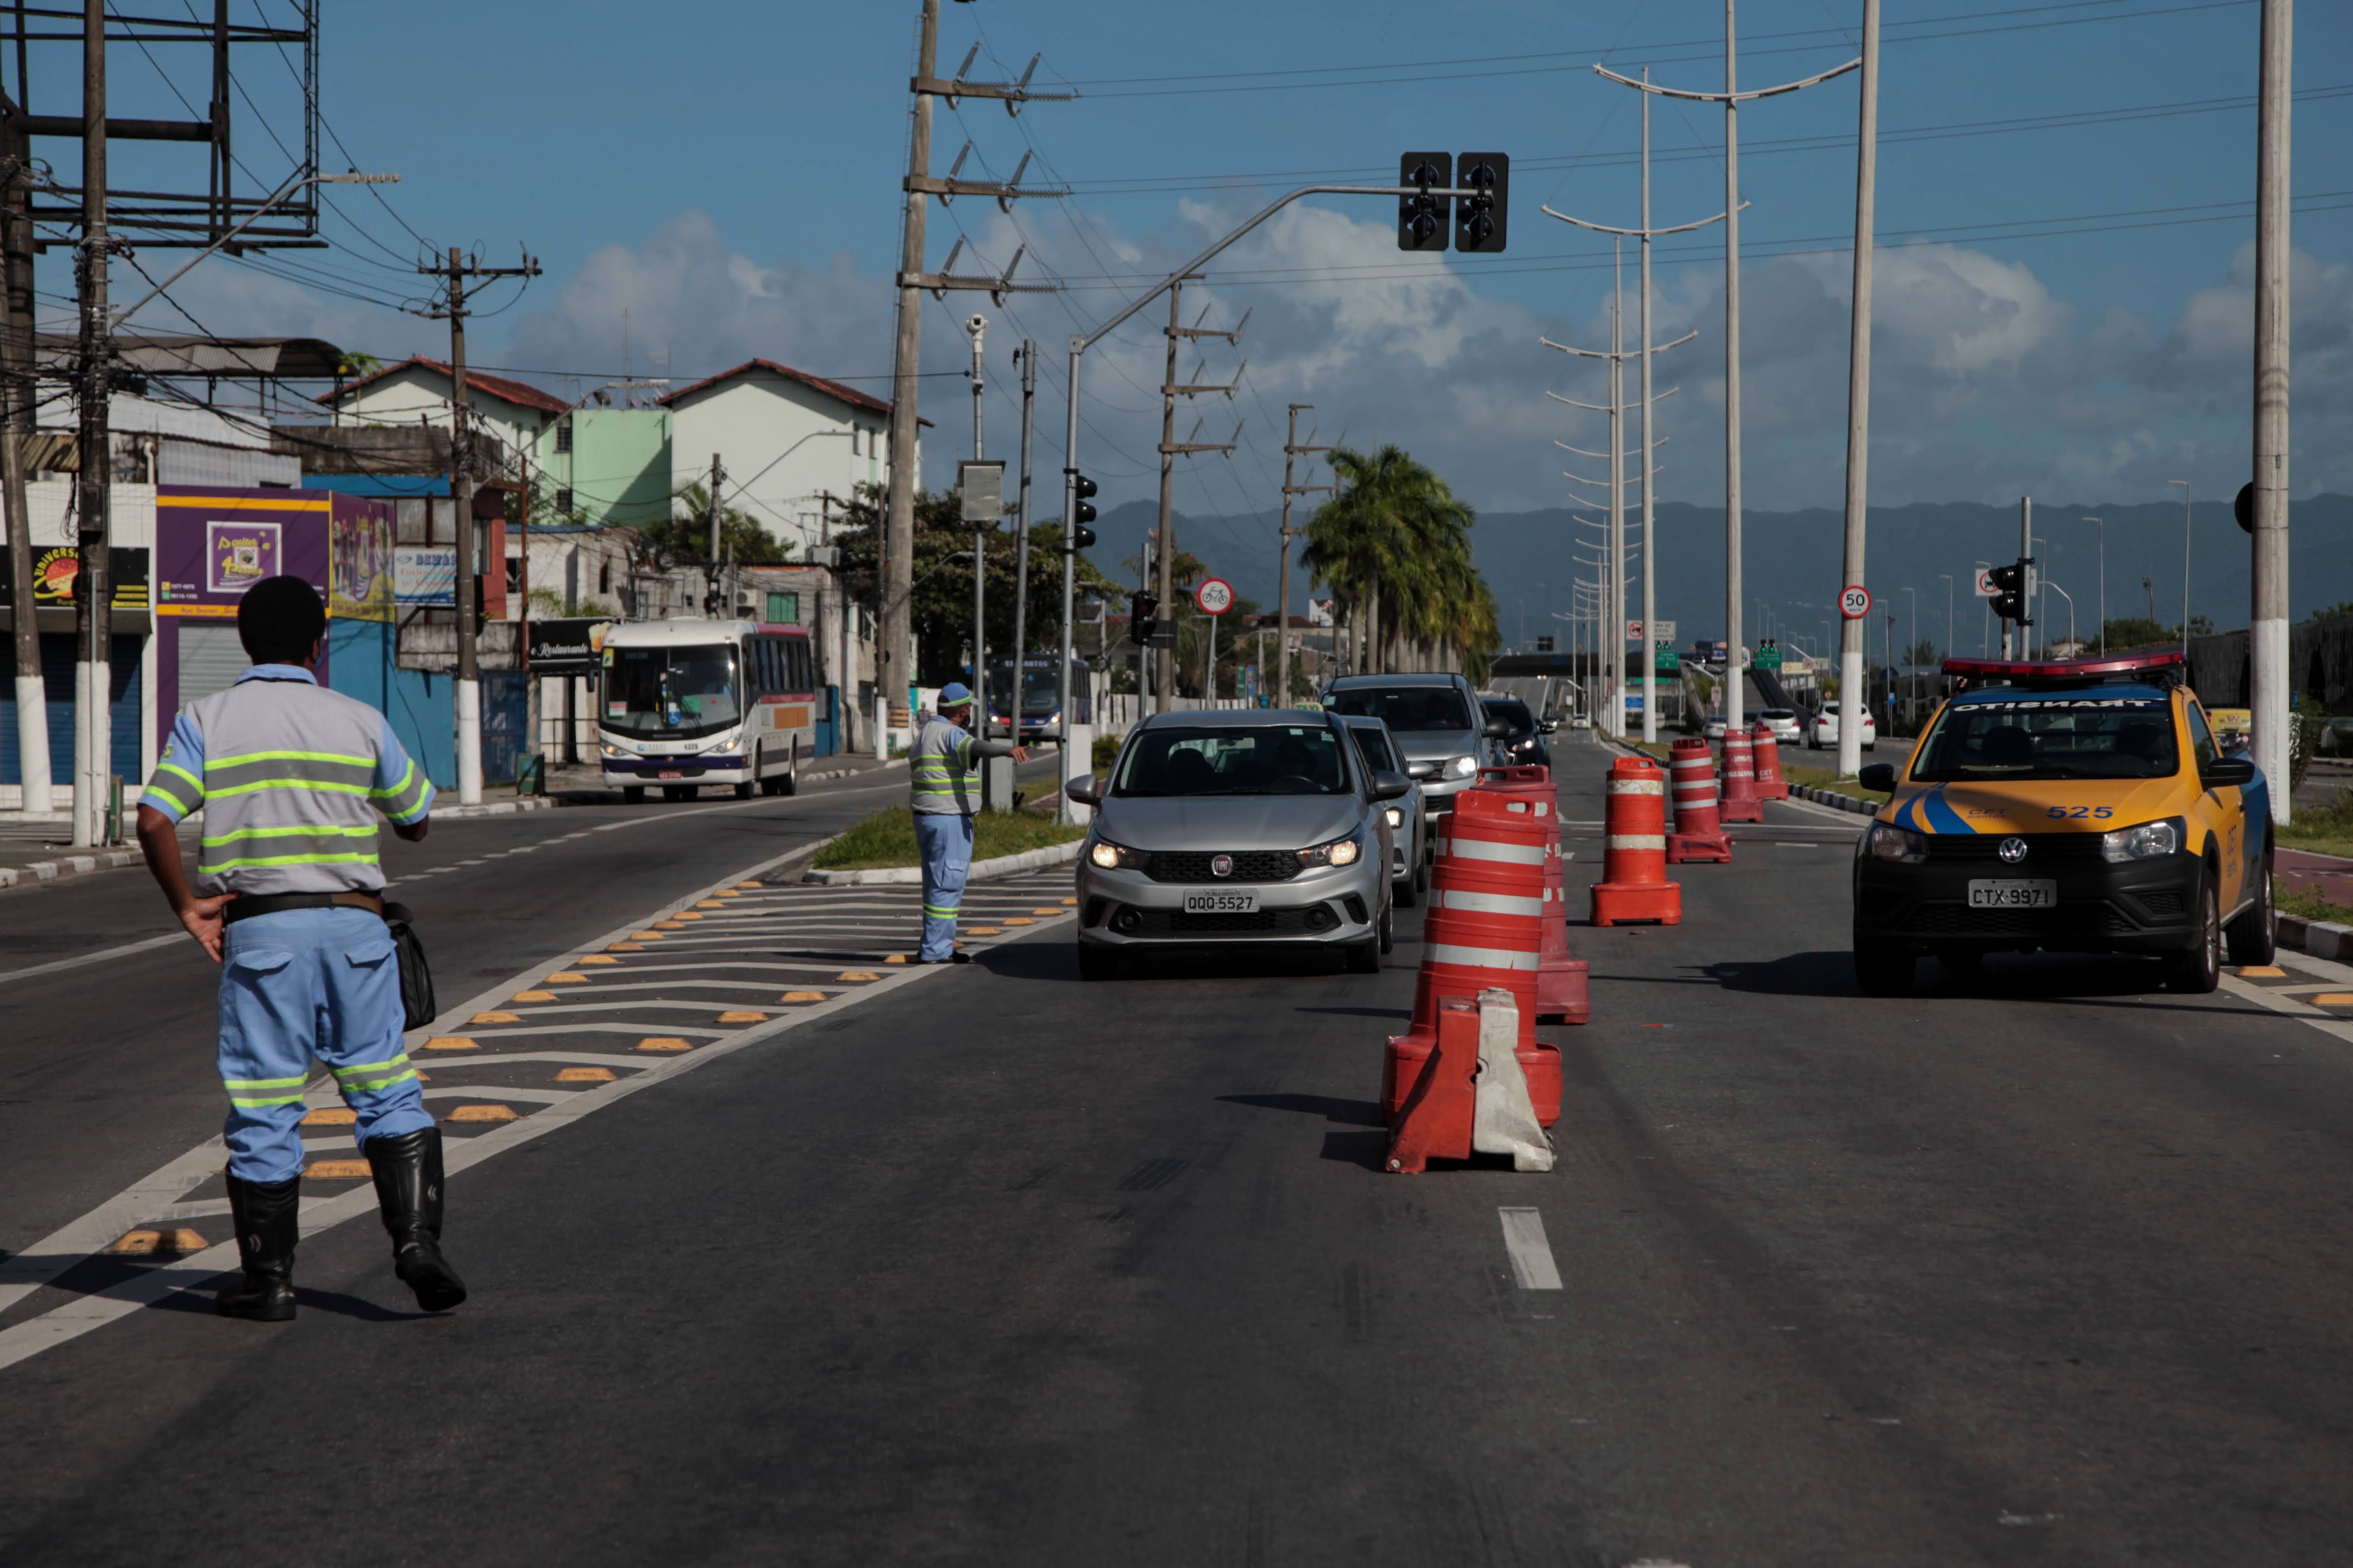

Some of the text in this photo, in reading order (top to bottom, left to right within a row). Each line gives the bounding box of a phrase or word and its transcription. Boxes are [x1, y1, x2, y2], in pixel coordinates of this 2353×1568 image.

[1846, 594, 1865, 606] 50
[537, 642, 588, 657] Restaurante
[2047, 806, 2112, 818] 525
[1215, 861, 1228, 871] FIAT
